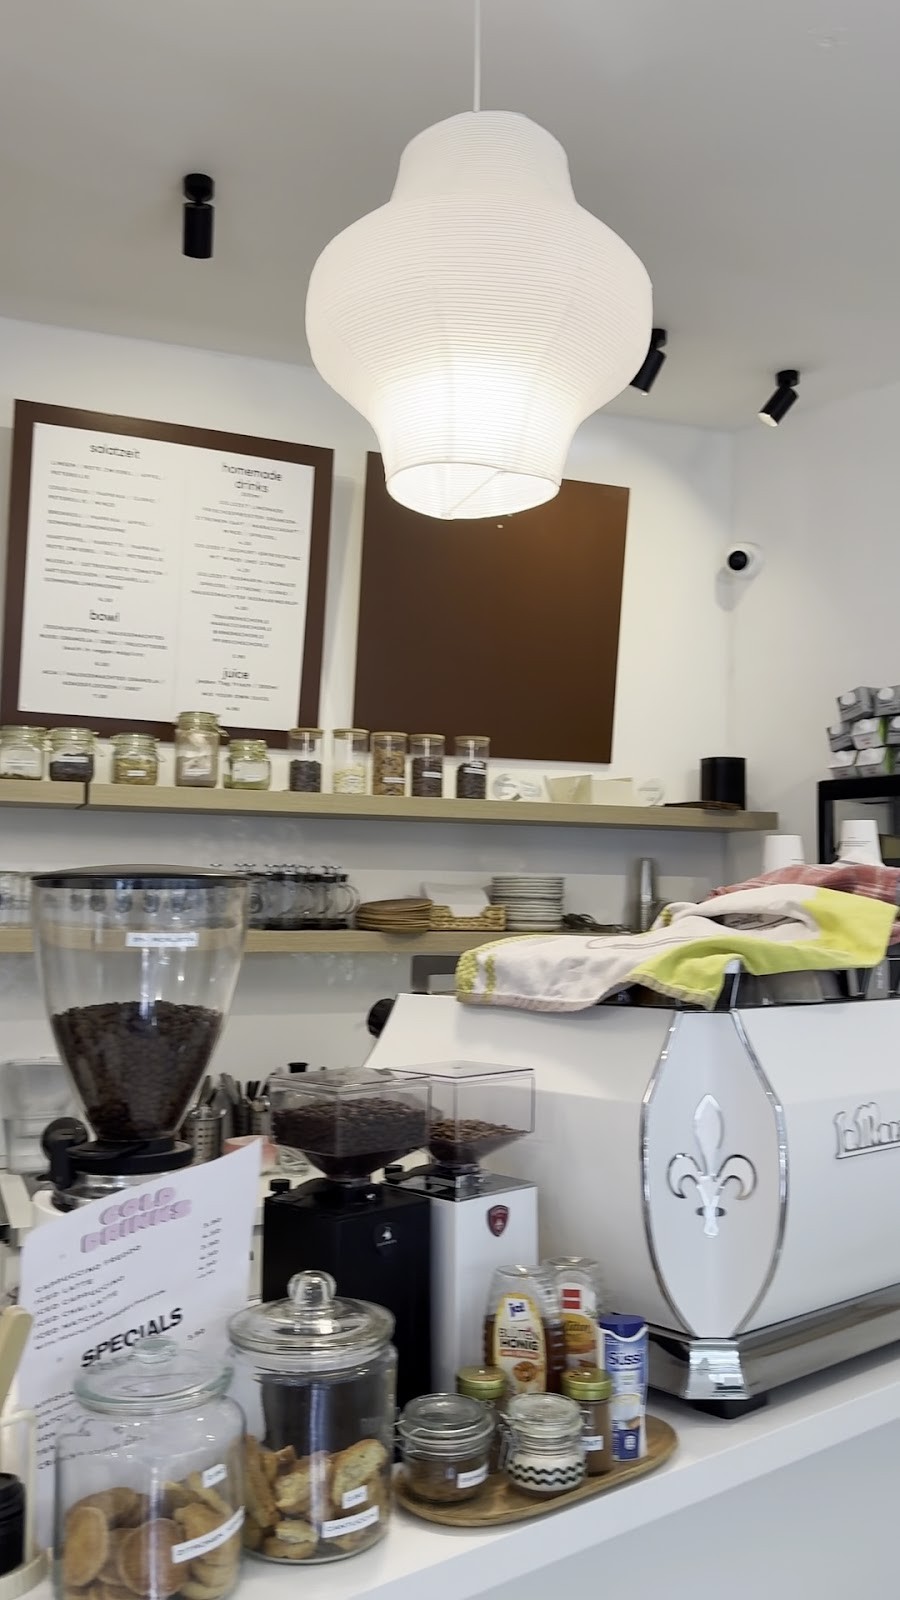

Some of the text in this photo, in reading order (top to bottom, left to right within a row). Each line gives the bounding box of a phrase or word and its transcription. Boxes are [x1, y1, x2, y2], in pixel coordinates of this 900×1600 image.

[221, 461, 283, 481] homemade
[234, 479, 269, 492] drinks
[89, 609, 121, 622] bowl
[221, 666, 250, 681] juice
[98, 1186, 177, 1226] COLD
[80, 1199, 193, 1253] DRINKS
[80, 1306, 184, 1369] SPECIALS
[499, 1338, 539, 1351] HONIG
